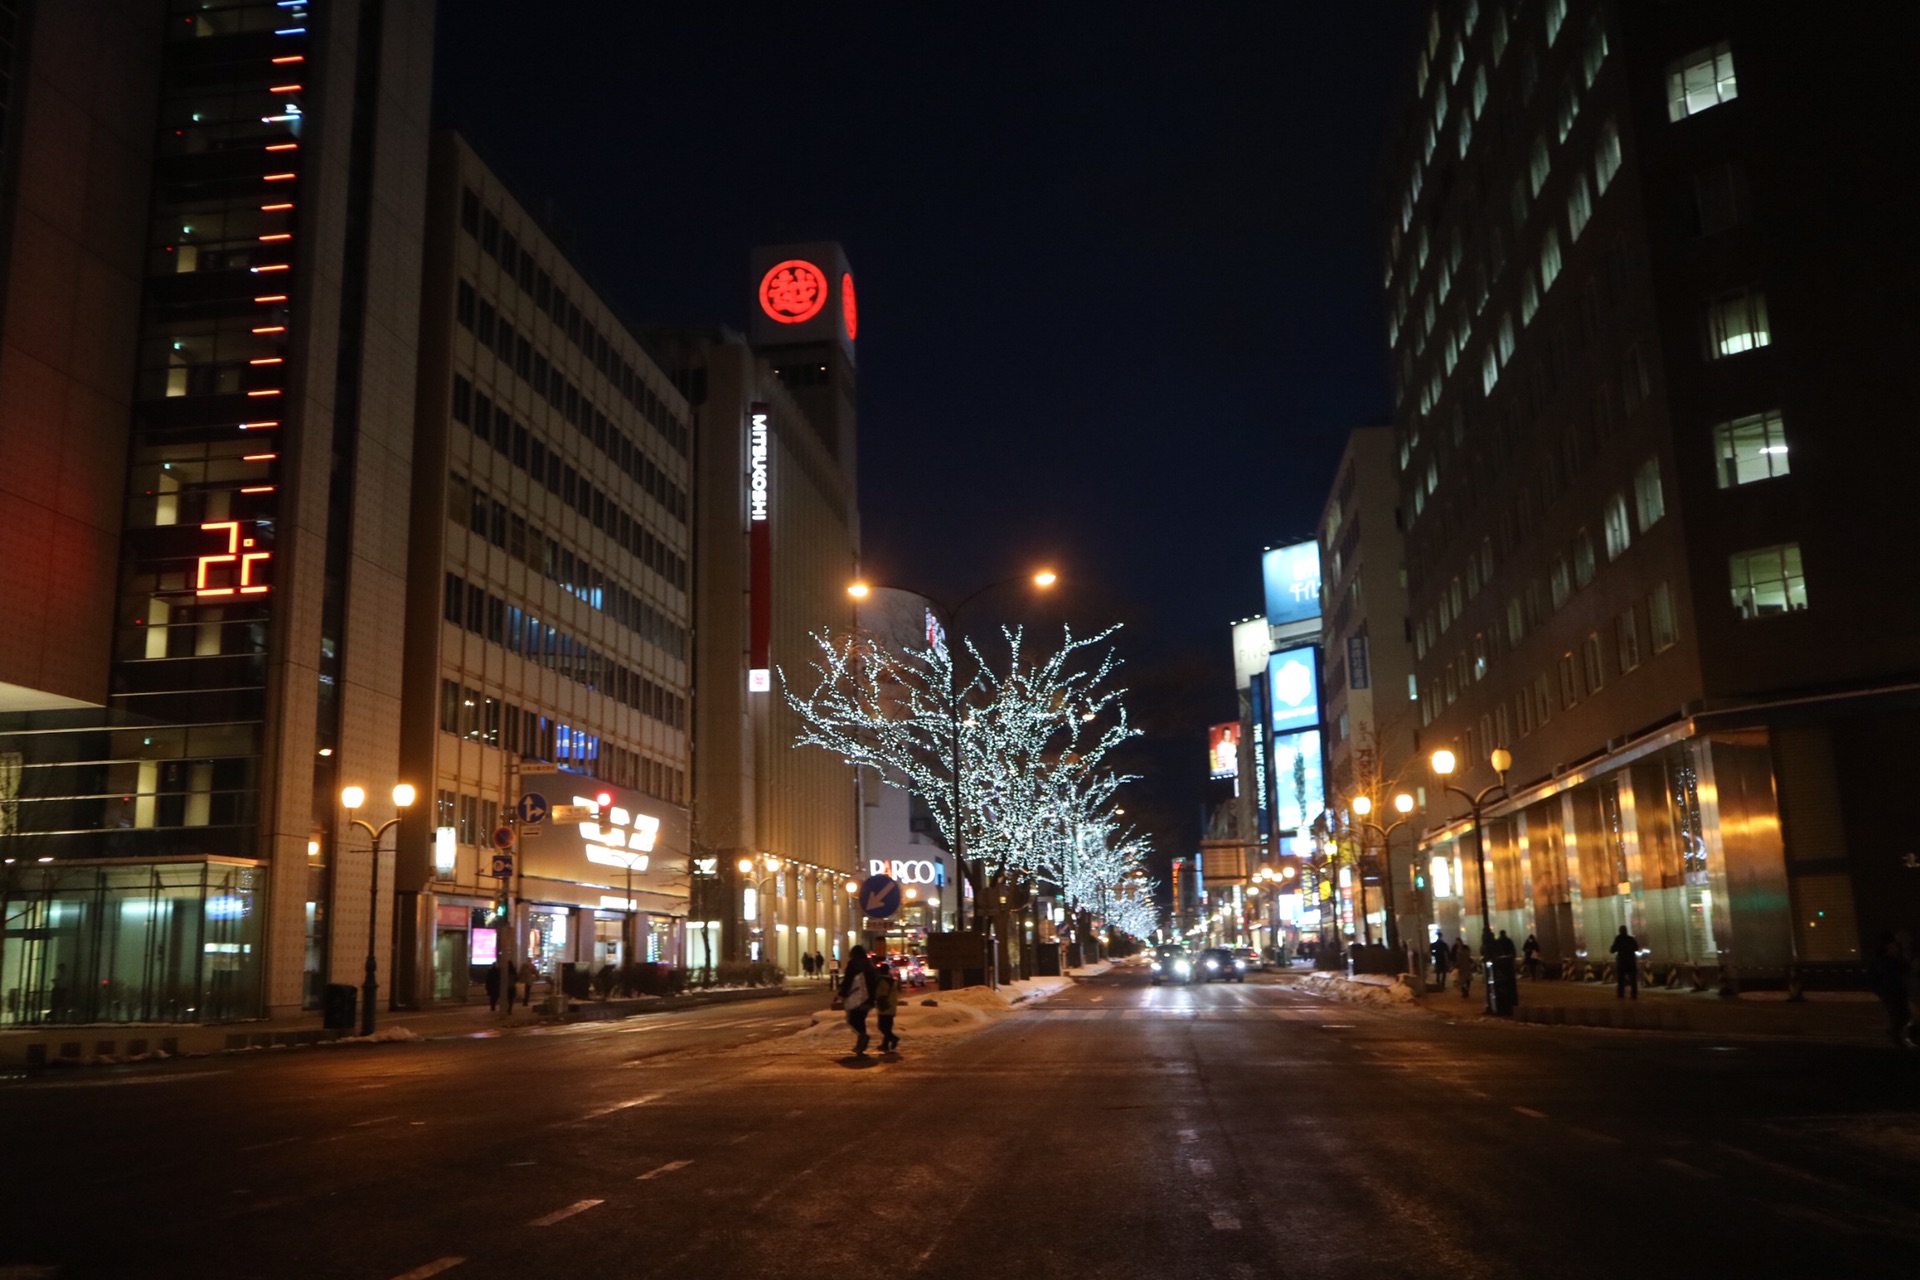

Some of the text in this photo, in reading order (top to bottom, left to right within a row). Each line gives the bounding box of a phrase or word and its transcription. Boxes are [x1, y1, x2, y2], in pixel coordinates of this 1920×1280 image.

[751, 414, 767, 521] MITSUKOSHI
[1253, 723, 1267, 811] THE SUIT COMPANY
[869, 859, 935, 884] PARCO
